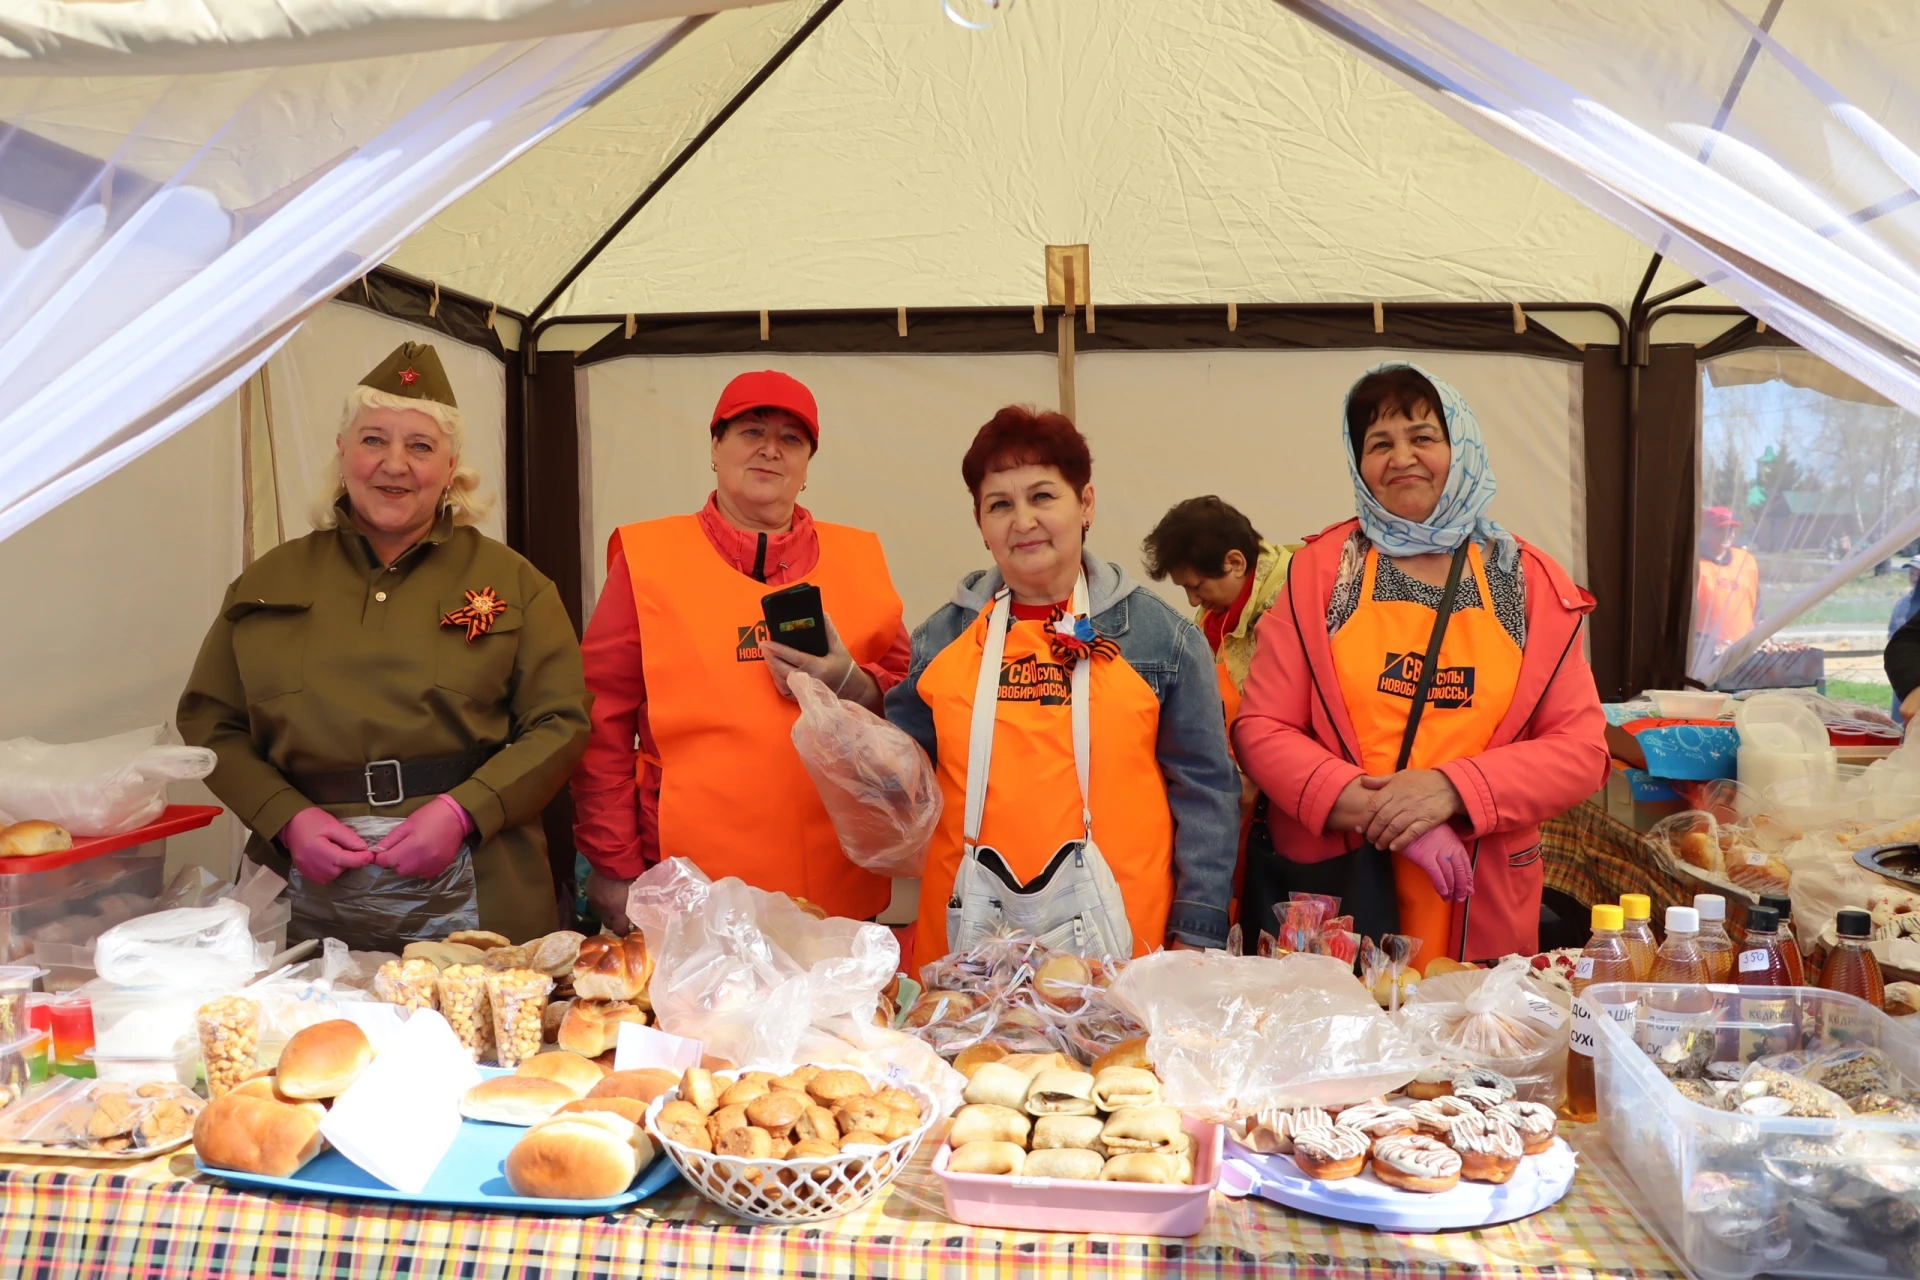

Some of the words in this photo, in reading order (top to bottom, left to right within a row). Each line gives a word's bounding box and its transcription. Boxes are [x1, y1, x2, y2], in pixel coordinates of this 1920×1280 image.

[1008, 660, 1037, 684] СВО
[1037, 666, 1063, 682] СУПЫ
[1402, 656, 1423, 682] СВ
[1436, 671, 1464, 685] СУПЫ
[997, 683, 1067, 699] ОВОБИРИЛЮССЫ
[1743, 952, 1765, 964] 350
